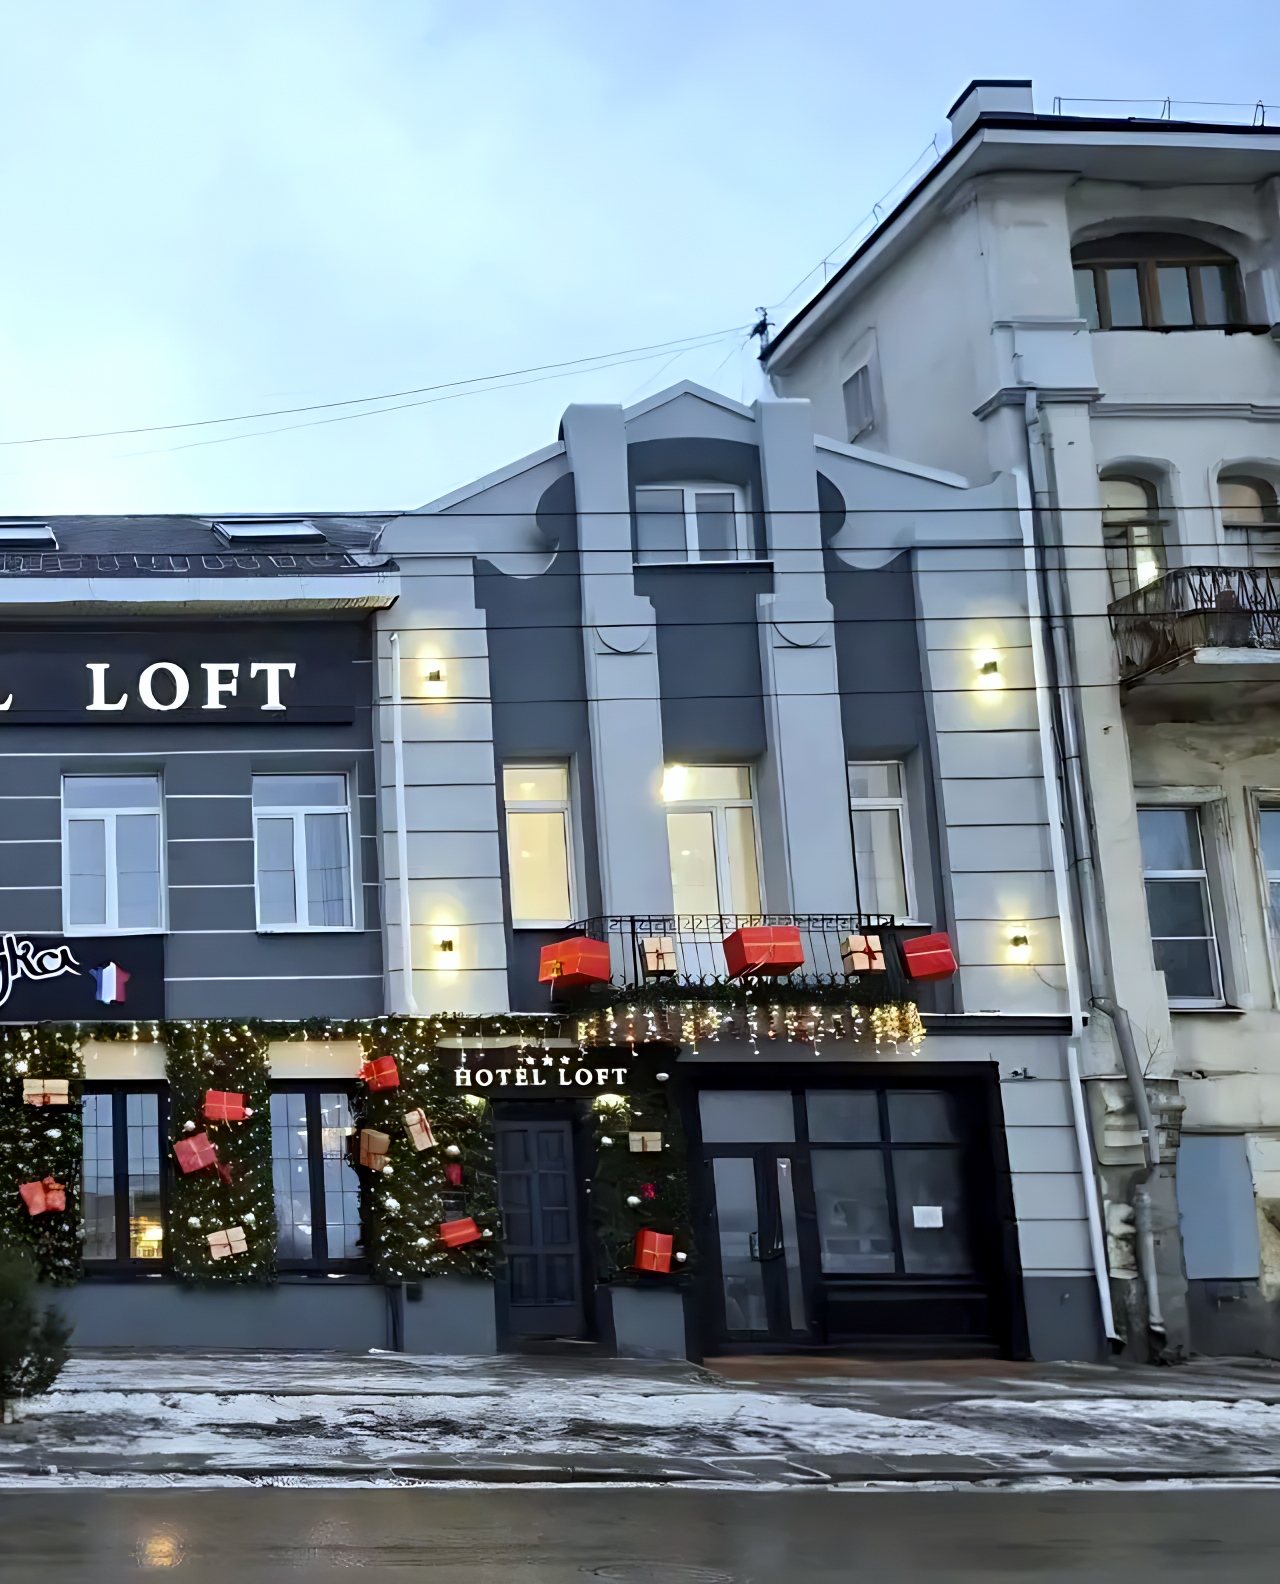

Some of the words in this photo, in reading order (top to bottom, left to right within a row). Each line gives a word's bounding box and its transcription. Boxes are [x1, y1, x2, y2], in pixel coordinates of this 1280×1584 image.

[85, 661, 297, 711] LOFT
[454, 1067, 547, 1087] HOTEL
[558, 1067, 628, 1086] LOFT
